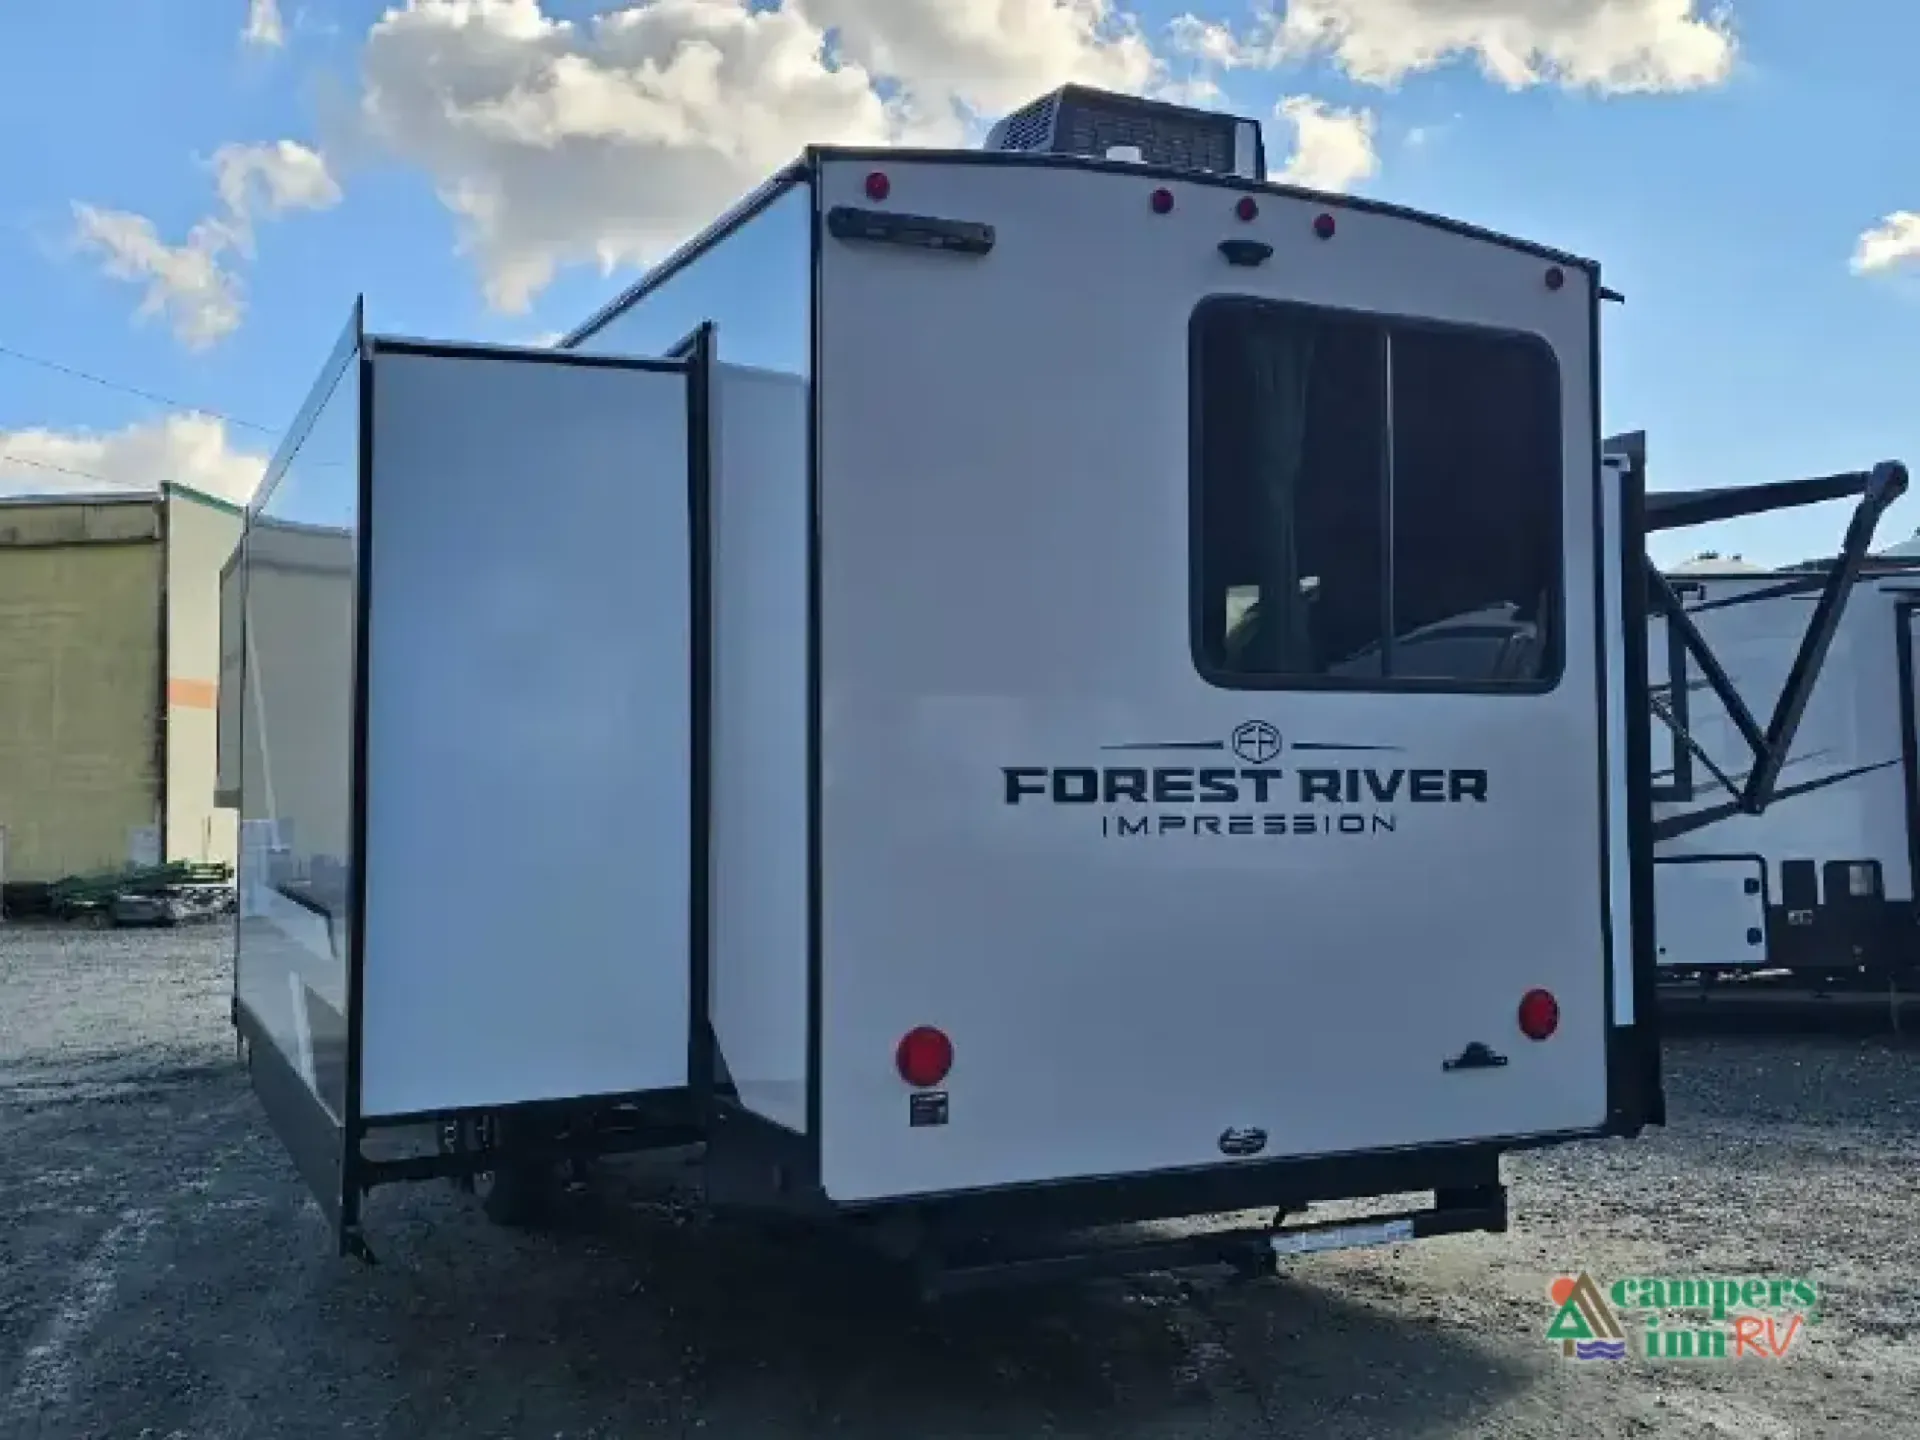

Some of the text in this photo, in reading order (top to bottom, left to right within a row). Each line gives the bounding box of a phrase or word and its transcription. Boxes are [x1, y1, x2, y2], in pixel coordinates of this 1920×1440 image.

[1002, 767, 1488, 804] FOREST RIVER
[1102, 814, 1397, 837] IMPRESSION
